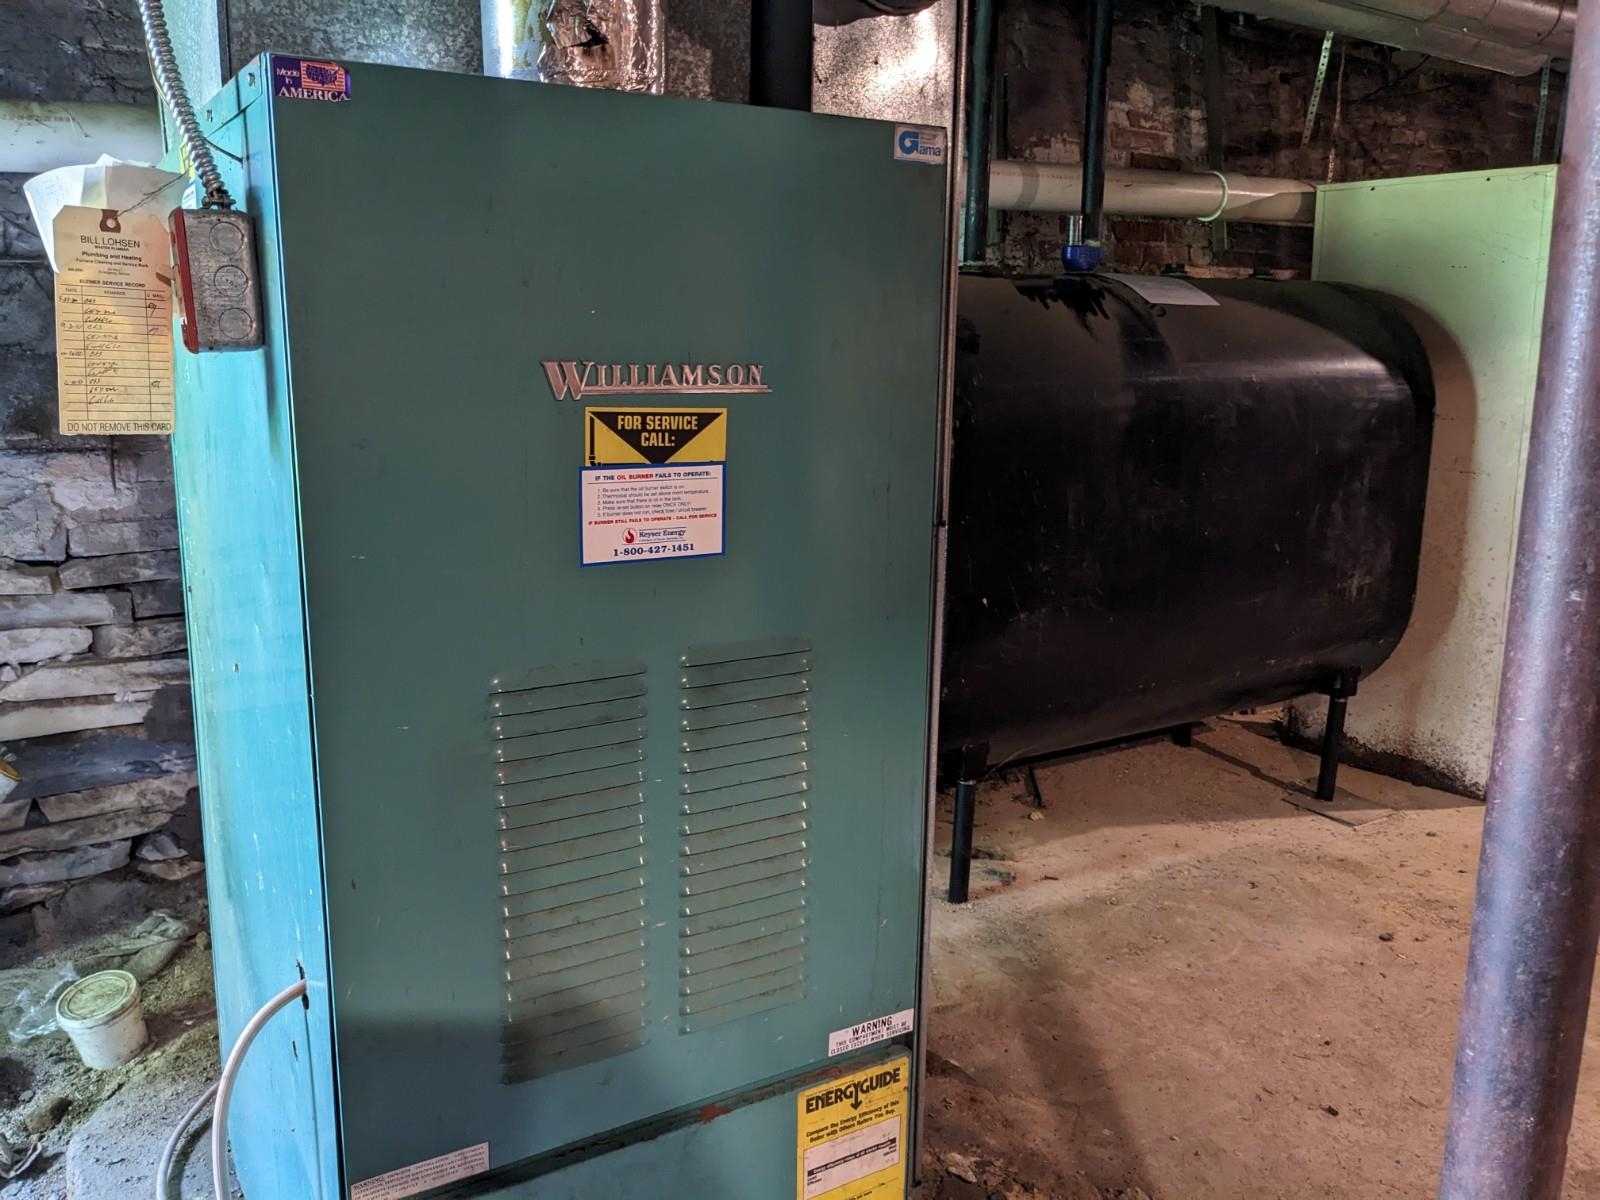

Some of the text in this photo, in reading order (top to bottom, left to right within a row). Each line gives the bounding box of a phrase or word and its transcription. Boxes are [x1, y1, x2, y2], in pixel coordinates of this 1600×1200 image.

[276, 67, 300, 77] Made
[278, 86, 351, 103] AMERICA
[80, 235, 140, 248] BILL LOHSEN
[82, 251, 109, 260] Plumbing
[121, 254, 142, 262] Heating
[541, 361, 765, 401] WILLIAMSON
[67, 422, 172, 432] DO NOT REMOVE THIS CARD
[617, 415, 699, 430] FOR SERVICE
[641, 431, 676, 447] CALL:
[638, 529, 687, 539] Keyser Energy
[613, 543, 695, 557] 1-800-427-1451
[835, 1020, 907, 1048] THIS COMPARTMENT MUST BE
[851, 1015, 893, 1037] WARNING
[830, 1025, 912, 1056] CLOSED EXCEPT WHEN SERVICING
[805, 1066, 902, 1114] ENERGYGUIDE
[806, 1125, 829, 1137] Compare
[839, 1115, 857, 1126] Energy
[858, 1105, 883, 1119] Efficiency
[883, 1102, 889, 1110] of
[890, 1099, 900, 1107] this
[826, 1127, 838, 1138] with
[838, 1122, 856, 1133] Others
[856, 1117, 873, 1128] Before
[874, 1112, 885, 1120] You
